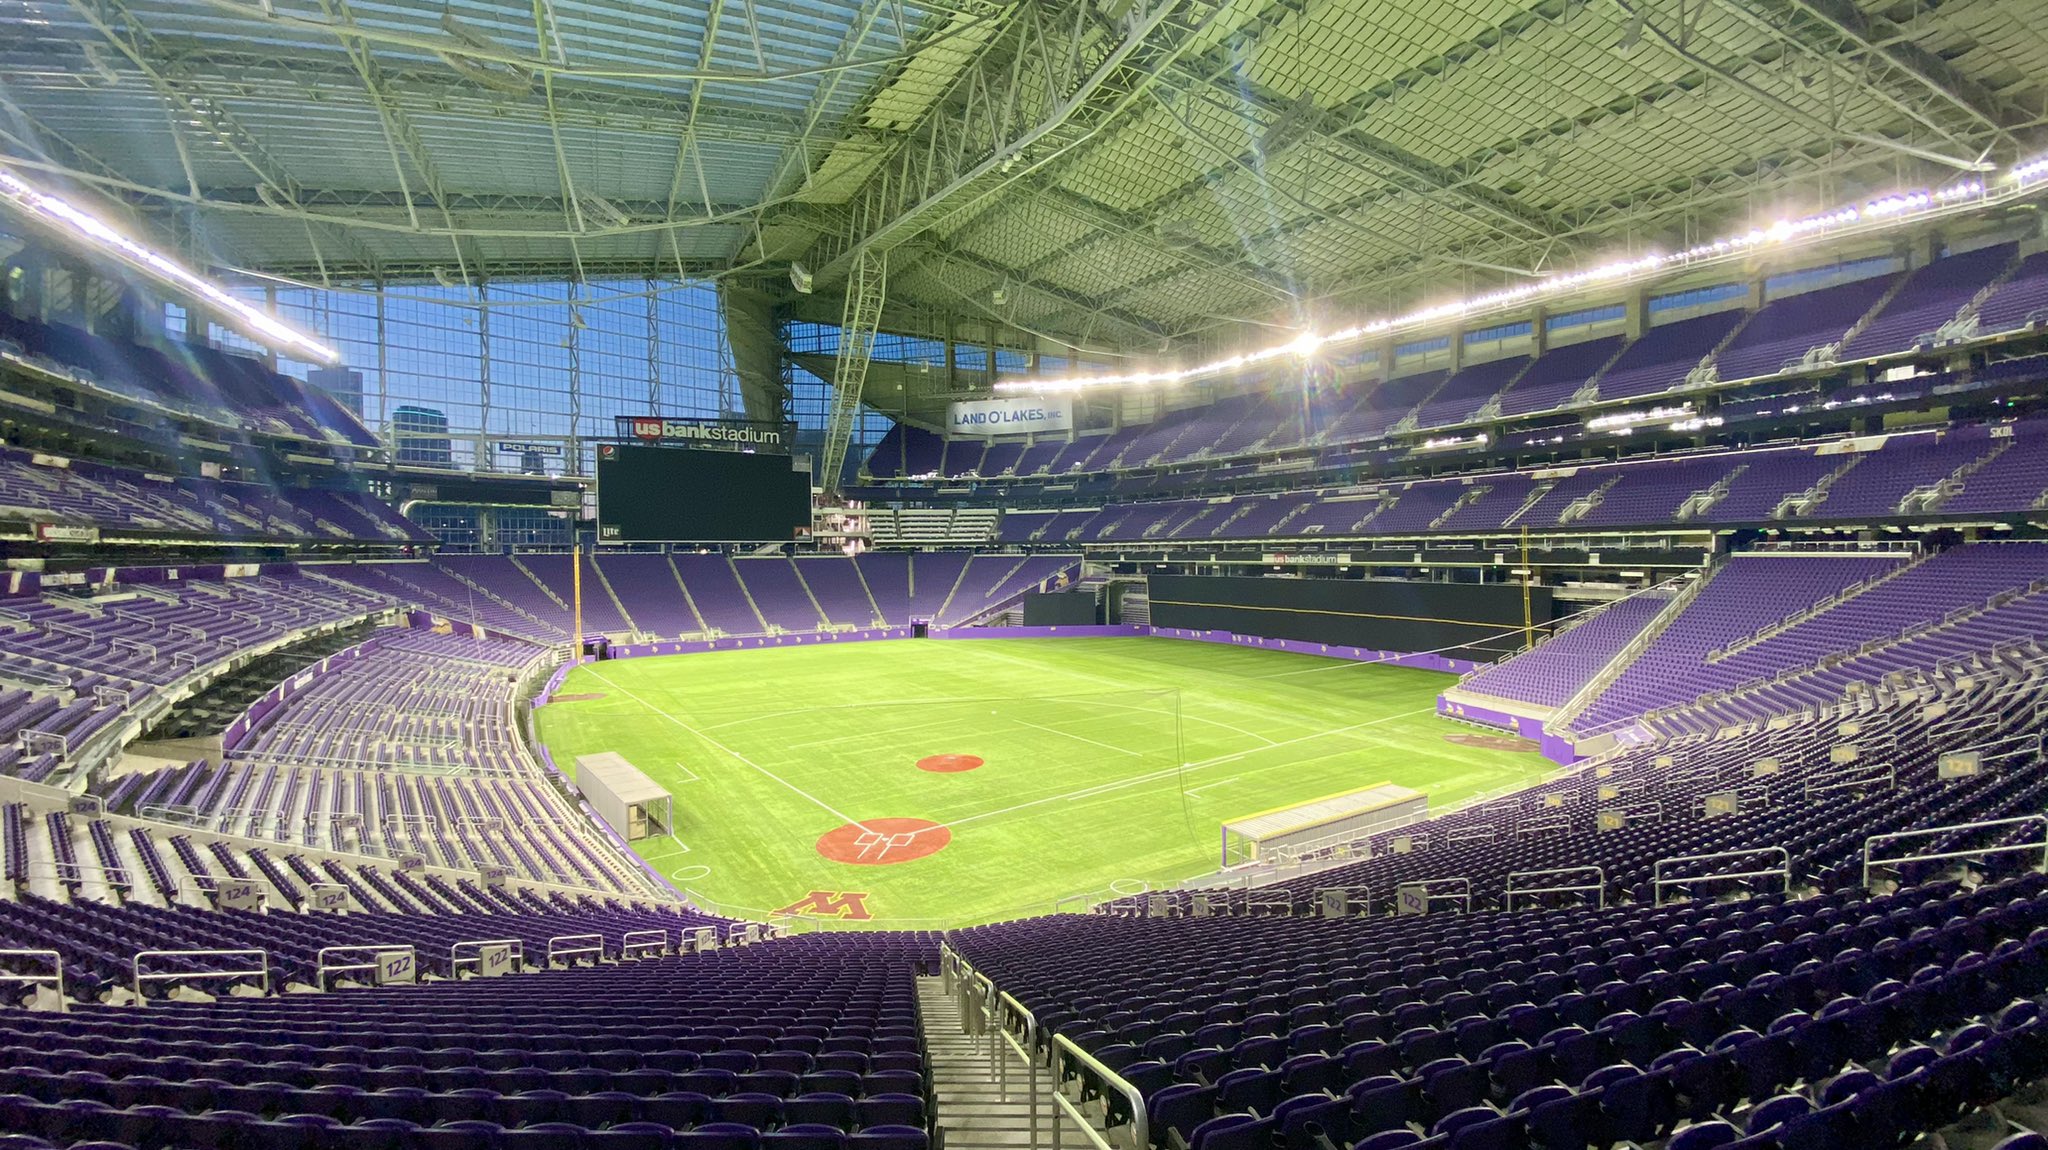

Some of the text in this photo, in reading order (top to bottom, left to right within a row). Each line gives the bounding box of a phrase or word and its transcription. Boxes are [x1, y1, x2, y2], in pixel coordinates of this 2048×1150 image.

[954, 413, 986, 425] LAND
[502, 443, 559, 454] POLARIS
[74, 802, 98, 813] 124
[403, 859, 422, 869] 124
[225, 886, 250, 900] 124
[322, 892, 346, 905] 124
[1325, 895, 1341, 912] 122
[1403, 892, 1422, 911] 122
[488, 949, 508, 967] 122
[386, 956, 411, 978] 122
